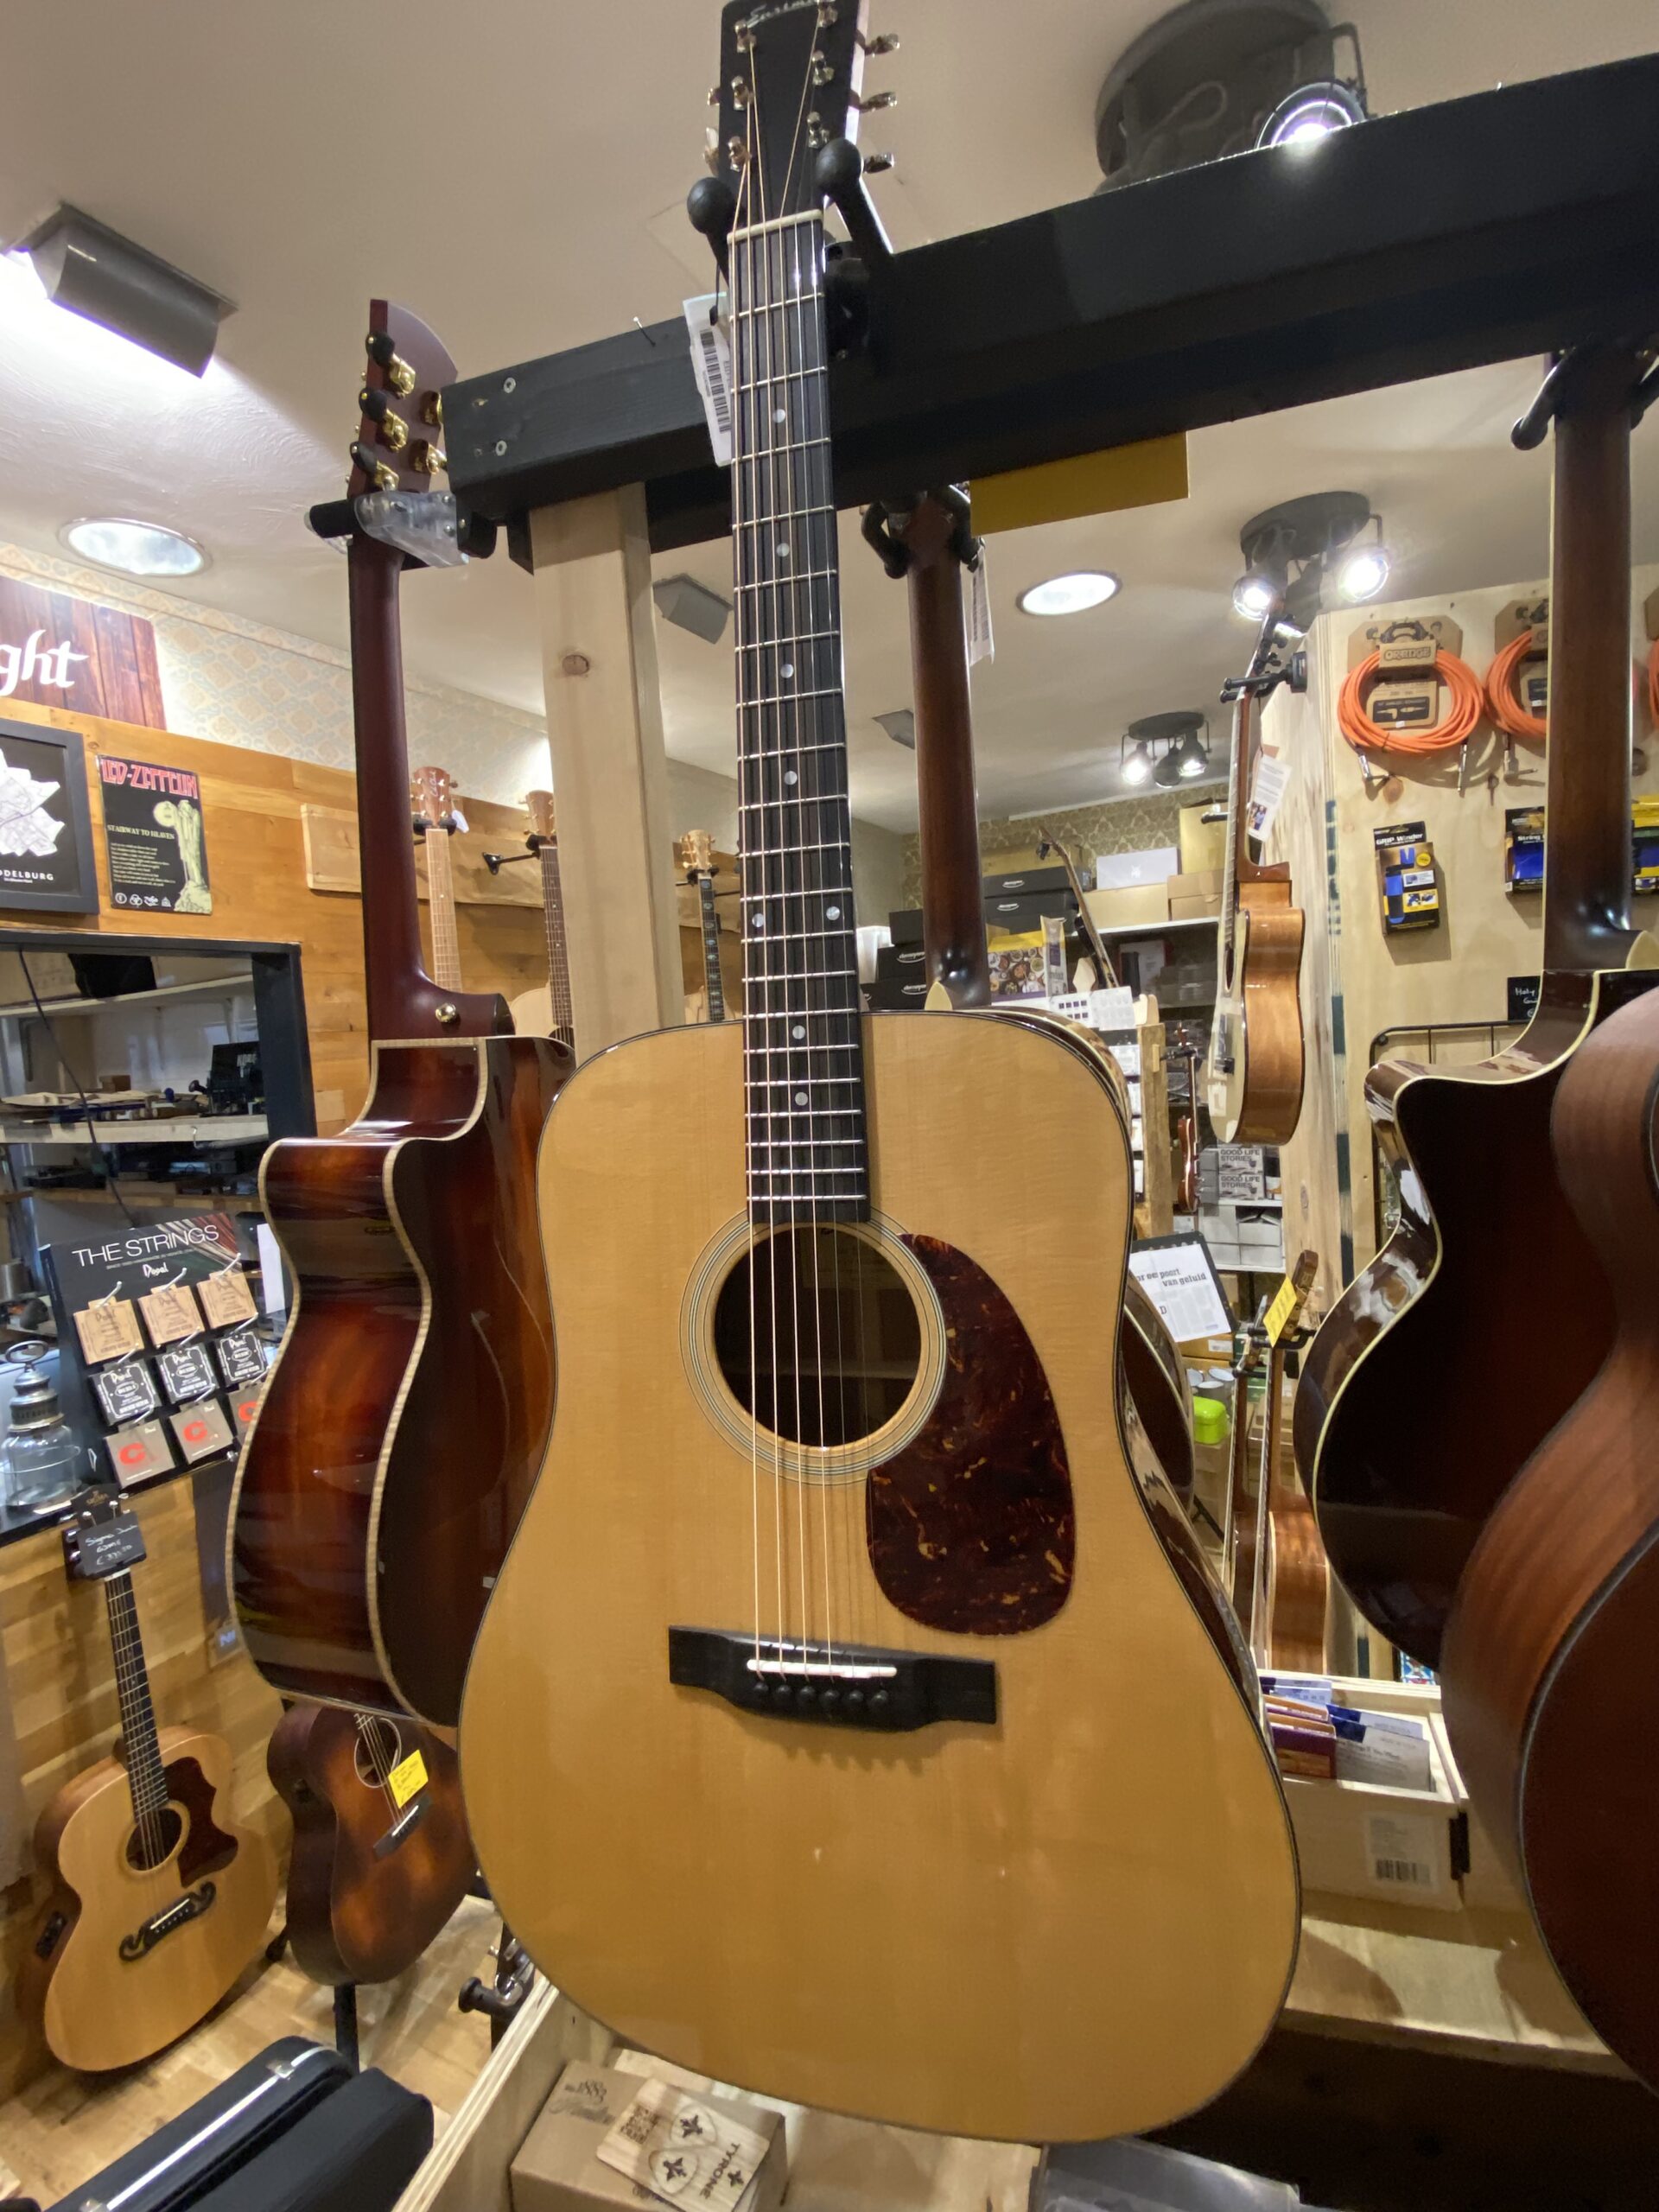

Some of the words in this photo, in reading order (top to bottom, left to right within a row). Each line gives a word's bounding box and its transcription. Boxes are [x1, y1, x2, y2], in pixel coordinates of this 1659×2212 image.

[141, 828, 150, 837] TO
[1376, 836, 1395, 846] GRIP
[1396, 833, 1424, 843] Winder
[72, 1243, 124, 1267] THE
[125, 1224, 219, 1257] STRINGS
[1160, 1268, 1181, 1280] poort
[1179, 1273, 1207, 1286] geluid
[1159, 1306, 1167, 1315] D
[699, 2142, 741, 2200] TYRONE
